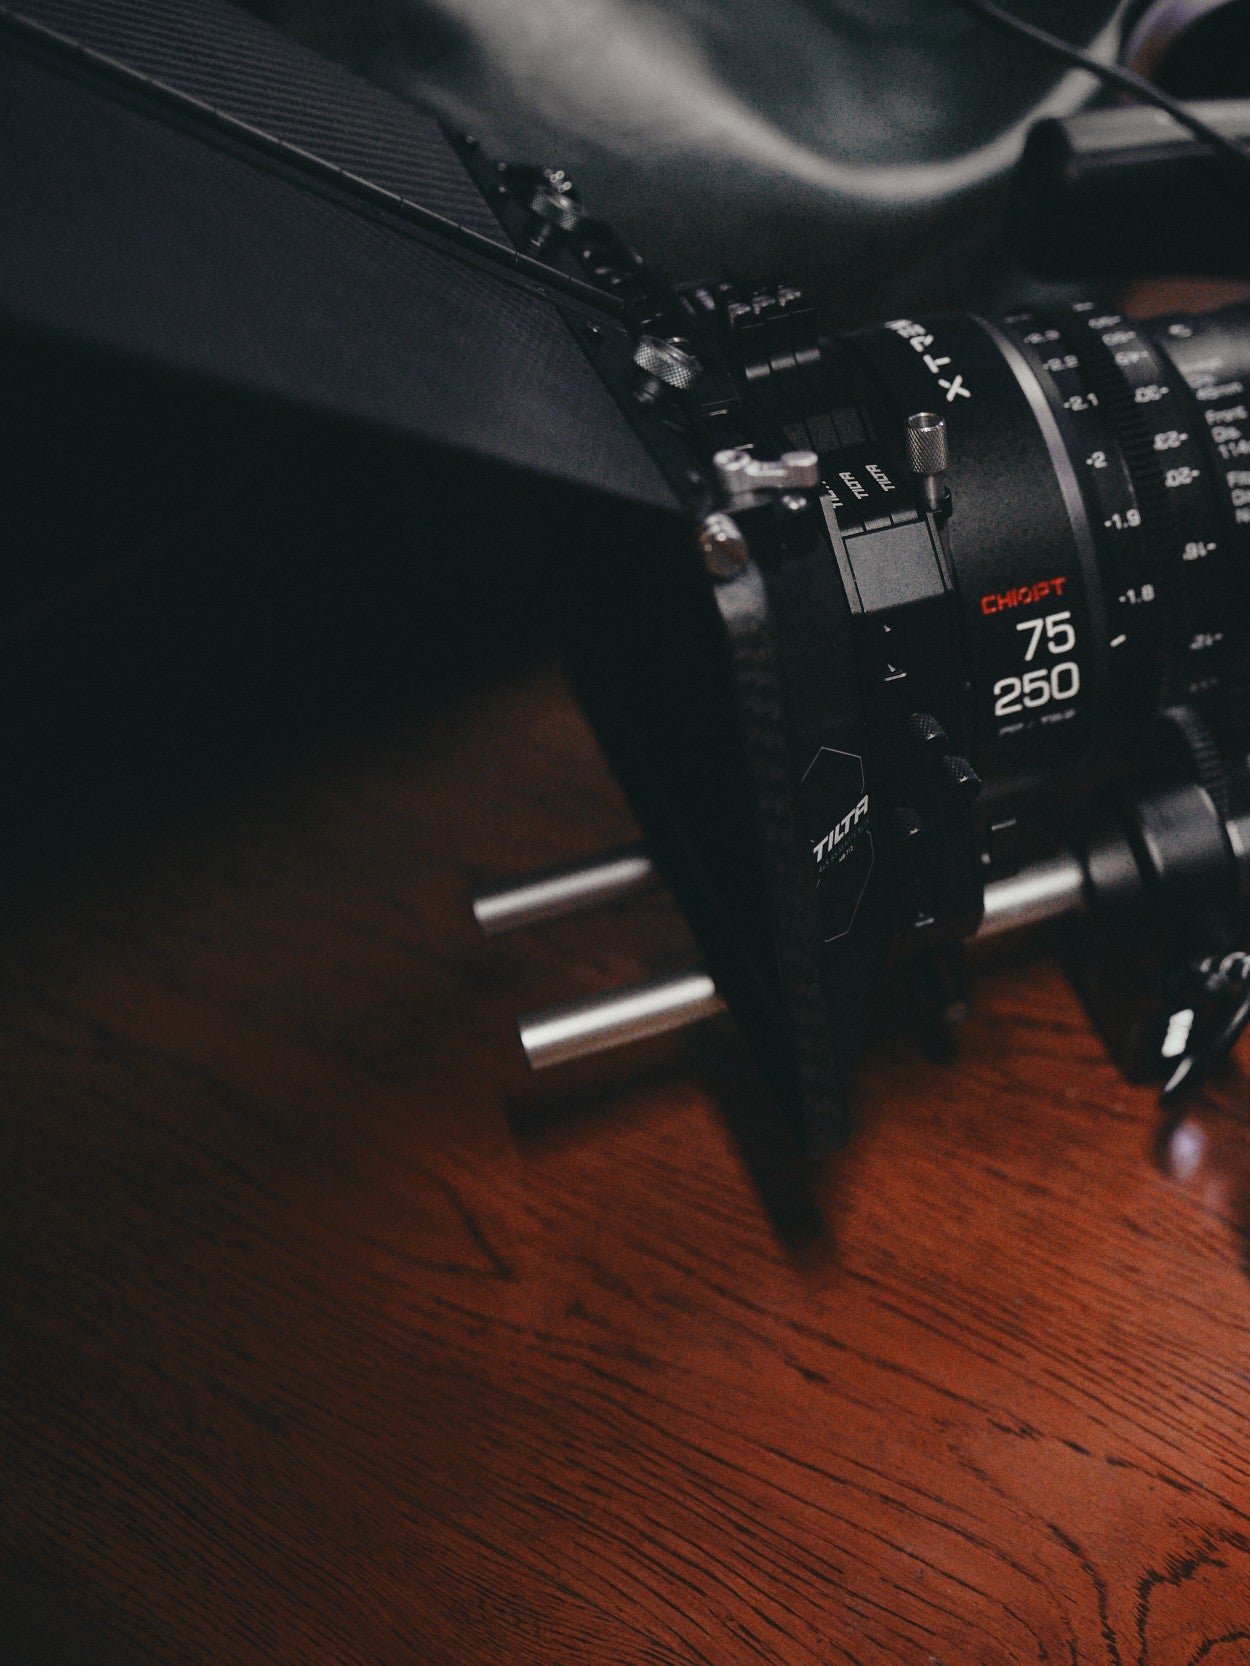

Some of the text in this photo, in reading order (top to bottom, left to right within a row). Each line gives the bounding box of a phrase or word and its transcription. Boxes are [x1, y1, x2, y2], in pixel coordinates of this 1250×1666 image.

[838, 472, 869, 500] TILTA
[865, 464, 896, 492] TILTA
[1016, 610, 1076, 662] 75
[993, 661, 1080, 716] 250
[813, 794, 869, 863] TILTA
